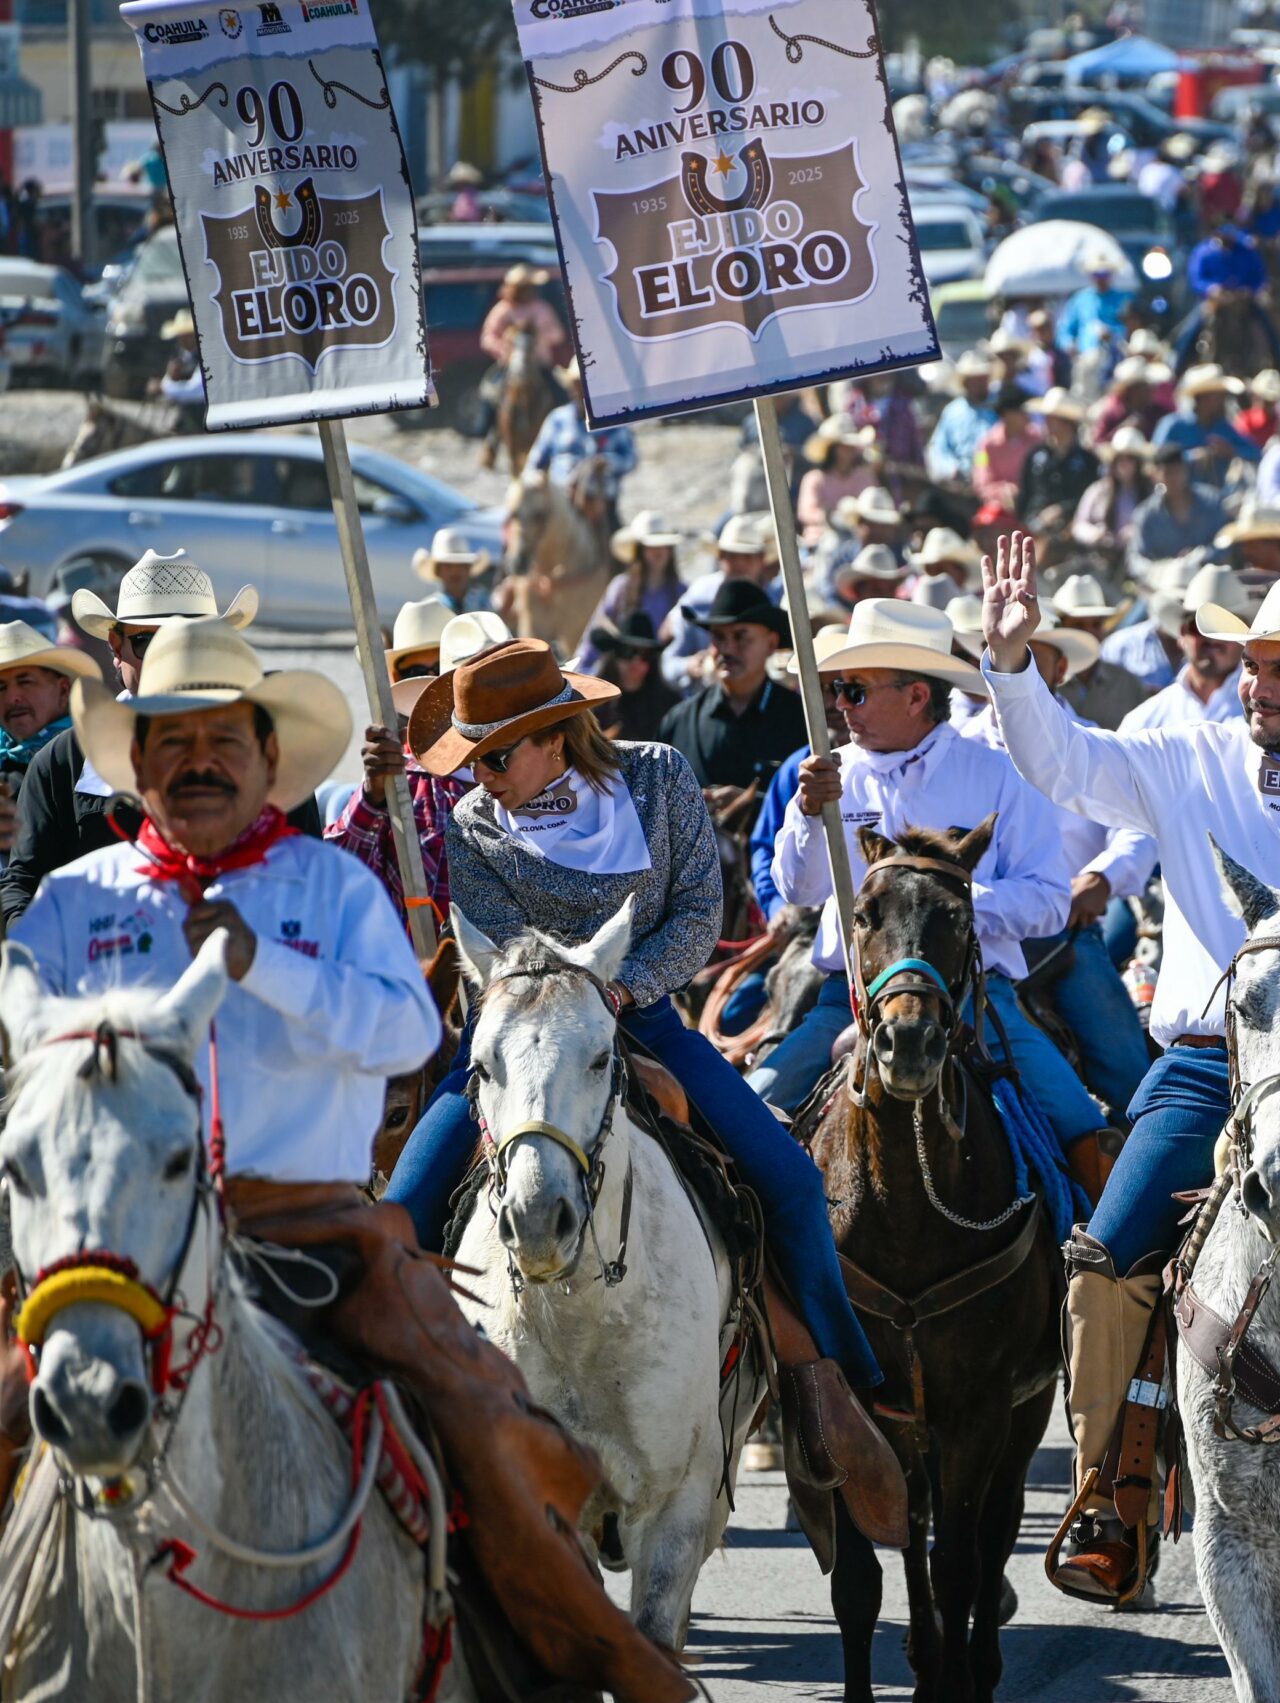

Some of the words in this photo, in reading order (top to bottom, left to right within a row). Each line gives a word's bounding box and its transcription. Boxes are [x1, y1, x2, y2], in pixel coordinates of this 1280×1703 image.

[144, 19, 208, 43] COAHUILA
[662, 40, 754, 114] 90
[236, 81, 304, 147] 90
[615, 99, 825, 160] ANIVERSARIO
[213, 144, 358, 186] ANIVERSARIO
[788, 167, 823, 185] 2025
[334, 210, 360, 226] 2025
[632, 197, 667, 215] 1935
[227, 226, 249, 241] 1935
[669, 200, 803, 259] EJIDO
[251, 241, 347, 287] EJIDO
